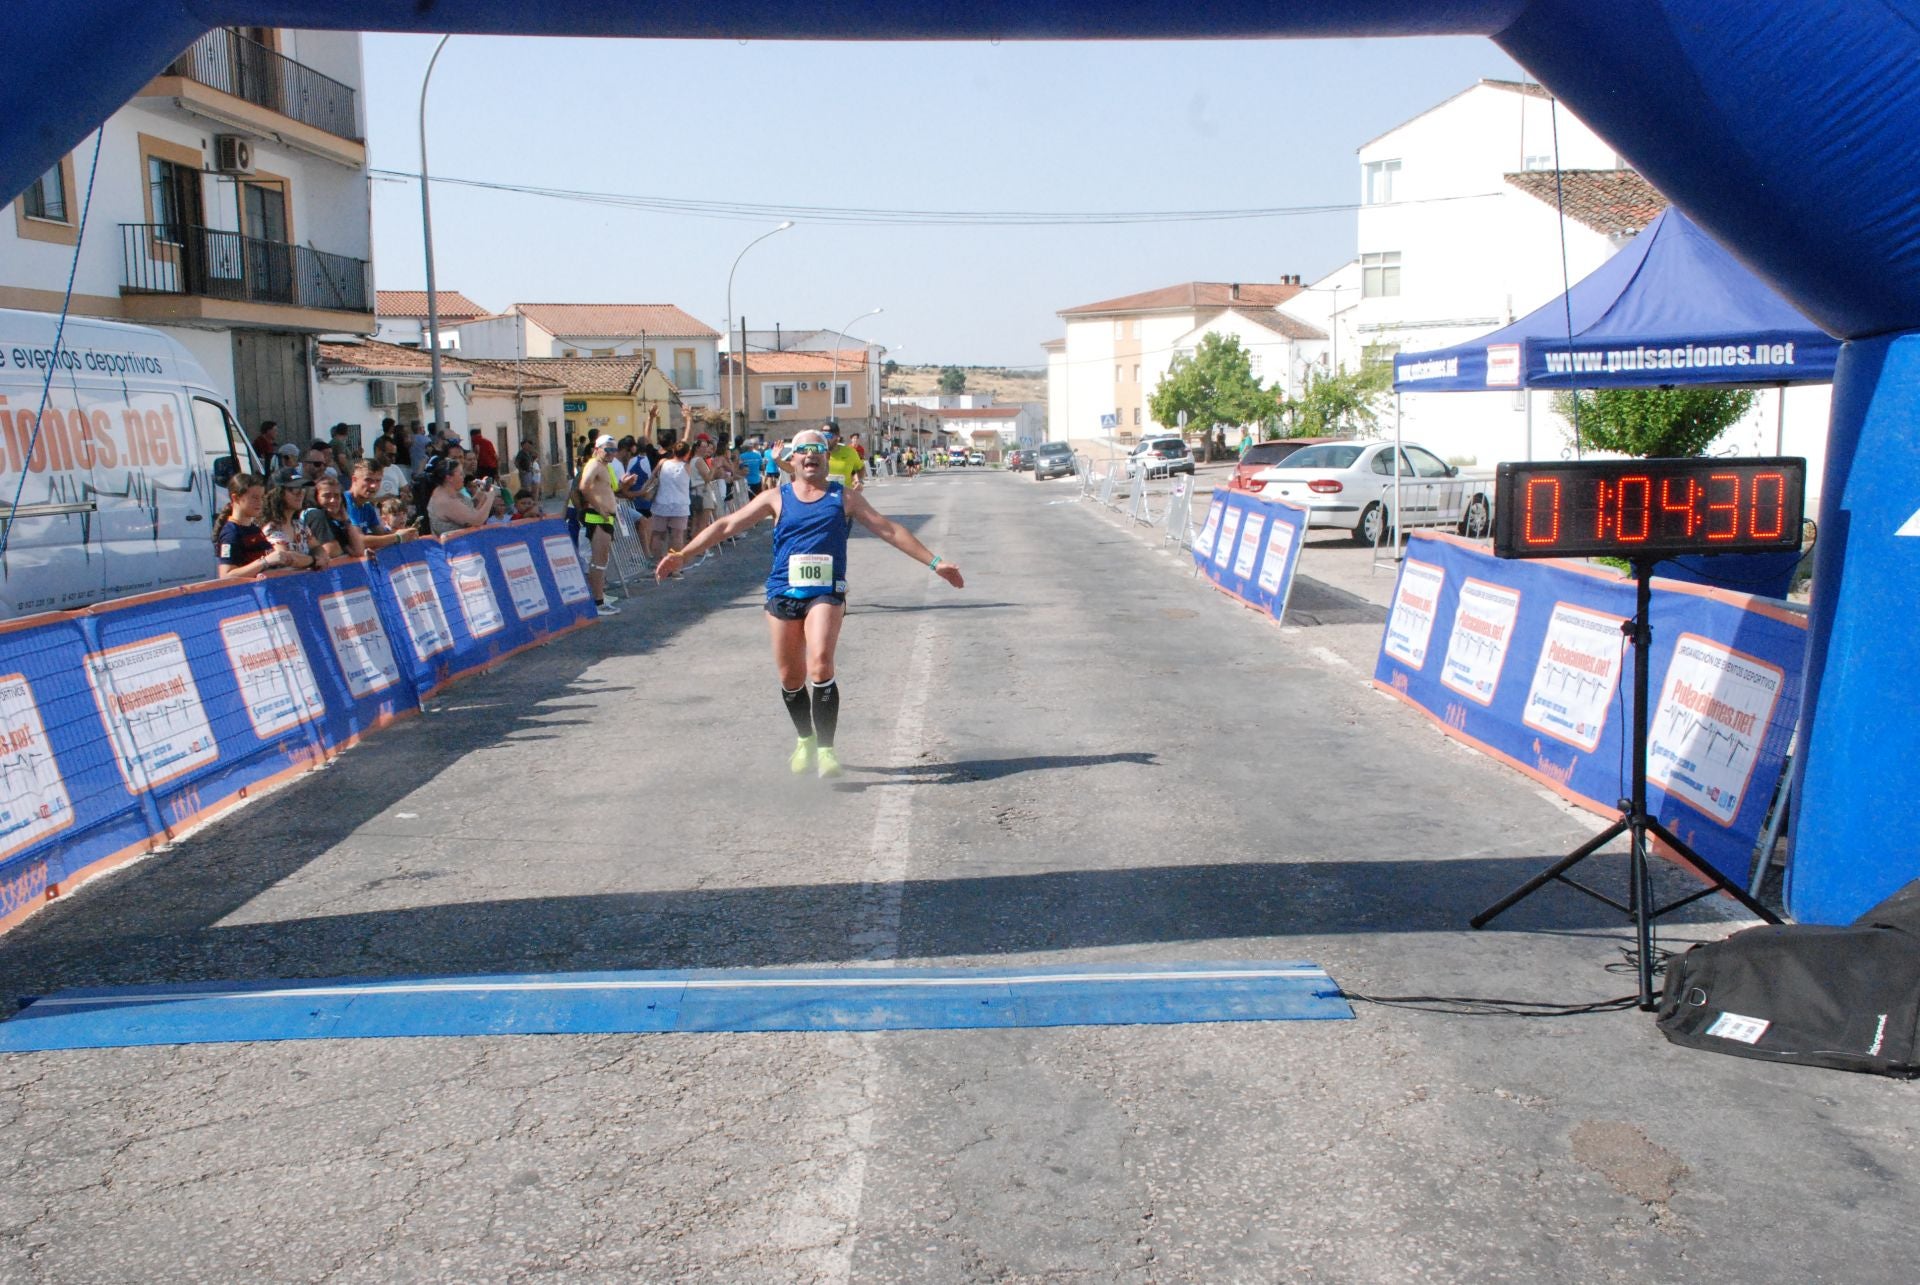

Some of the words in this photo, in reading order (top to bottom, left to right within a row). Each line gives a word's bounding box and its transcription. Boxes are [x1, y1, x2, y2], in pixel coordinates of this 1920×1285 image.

[13, 348, 82, 370] eventos
[85, 348, 163, 376] deportivos
[1545, 342, 1795, 373] www.pulsaciones.net
[0, 394, 182, 475] iones.net
[799, 565, 822, 579] 108
[1549, 639, 1612, 678] Pulsaciones.net
[1744, 668, 1777, 691] DEPORTIVOS
